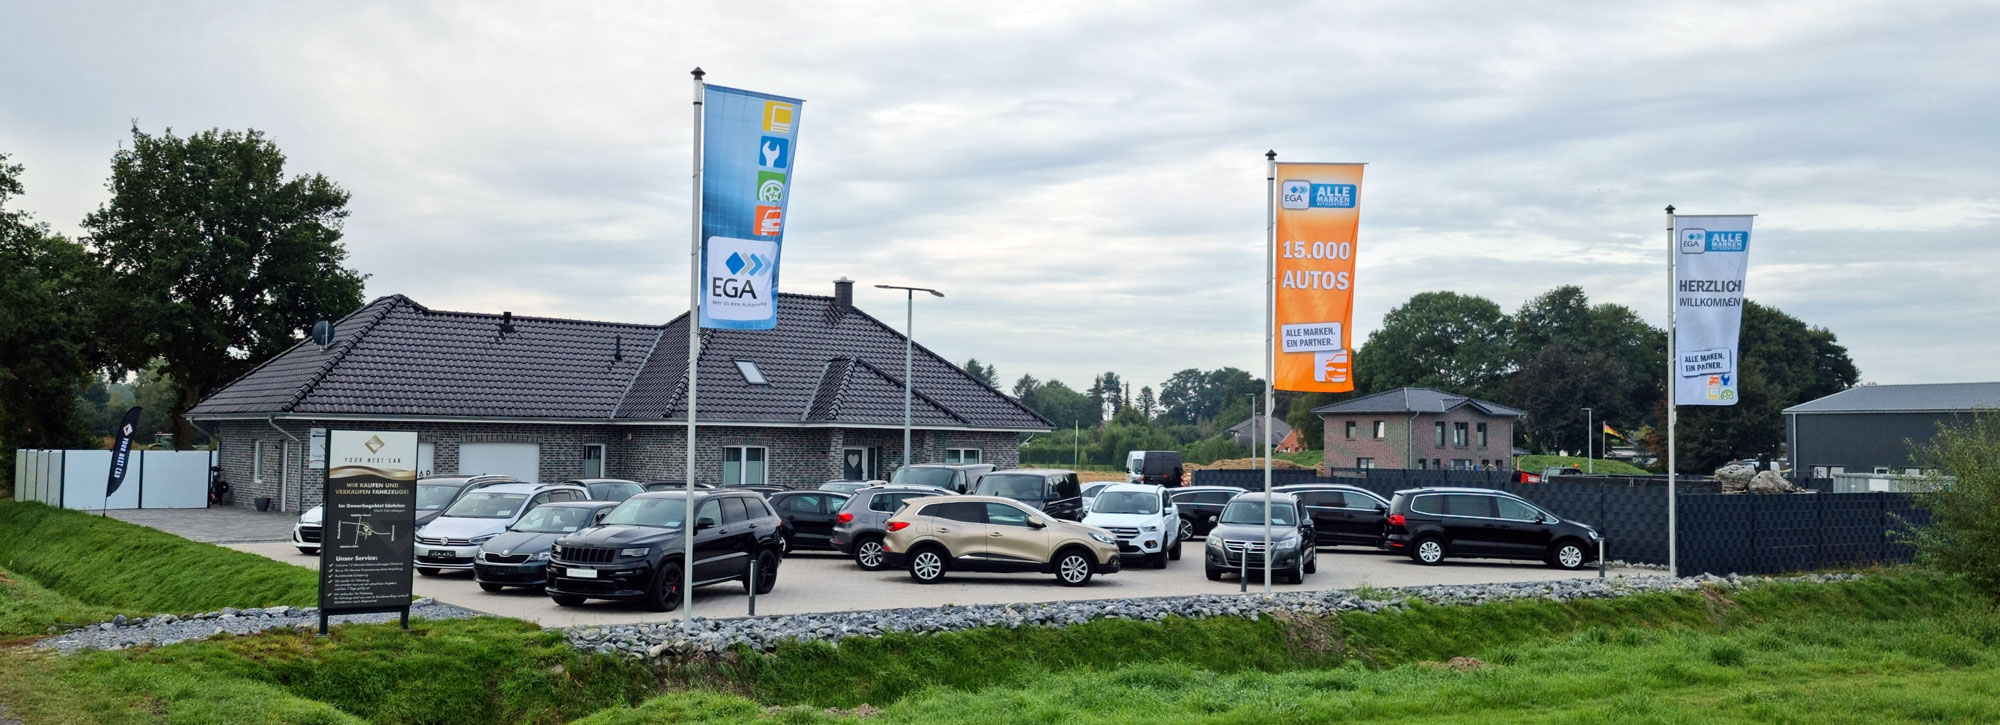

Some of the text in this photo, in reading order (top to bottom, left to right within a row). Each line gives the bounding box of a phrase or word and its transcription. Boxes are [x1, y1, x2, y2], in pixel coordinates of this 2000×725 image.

[1316, 186, 1350, 196] ALLE
[1284, 194, 1303, 202] EGA
[1711, 233, 1742, 241] ALLE
[1282, 240, 1351, 260] 15.000
[1282, 270, 1350, 290] AUTOS
[712, 276, 757, 300] EGA
[1679, 280, 1742, 292] HERZLICH
[1679, 297, 1741, 307] WILLKOMMEN
[1285, 327, 1336, 337] ALLE MARKEN.
[1286, 338, 1334, 347] EIN PARTNER.
[1684, 355, 1699, 363] ALLE
